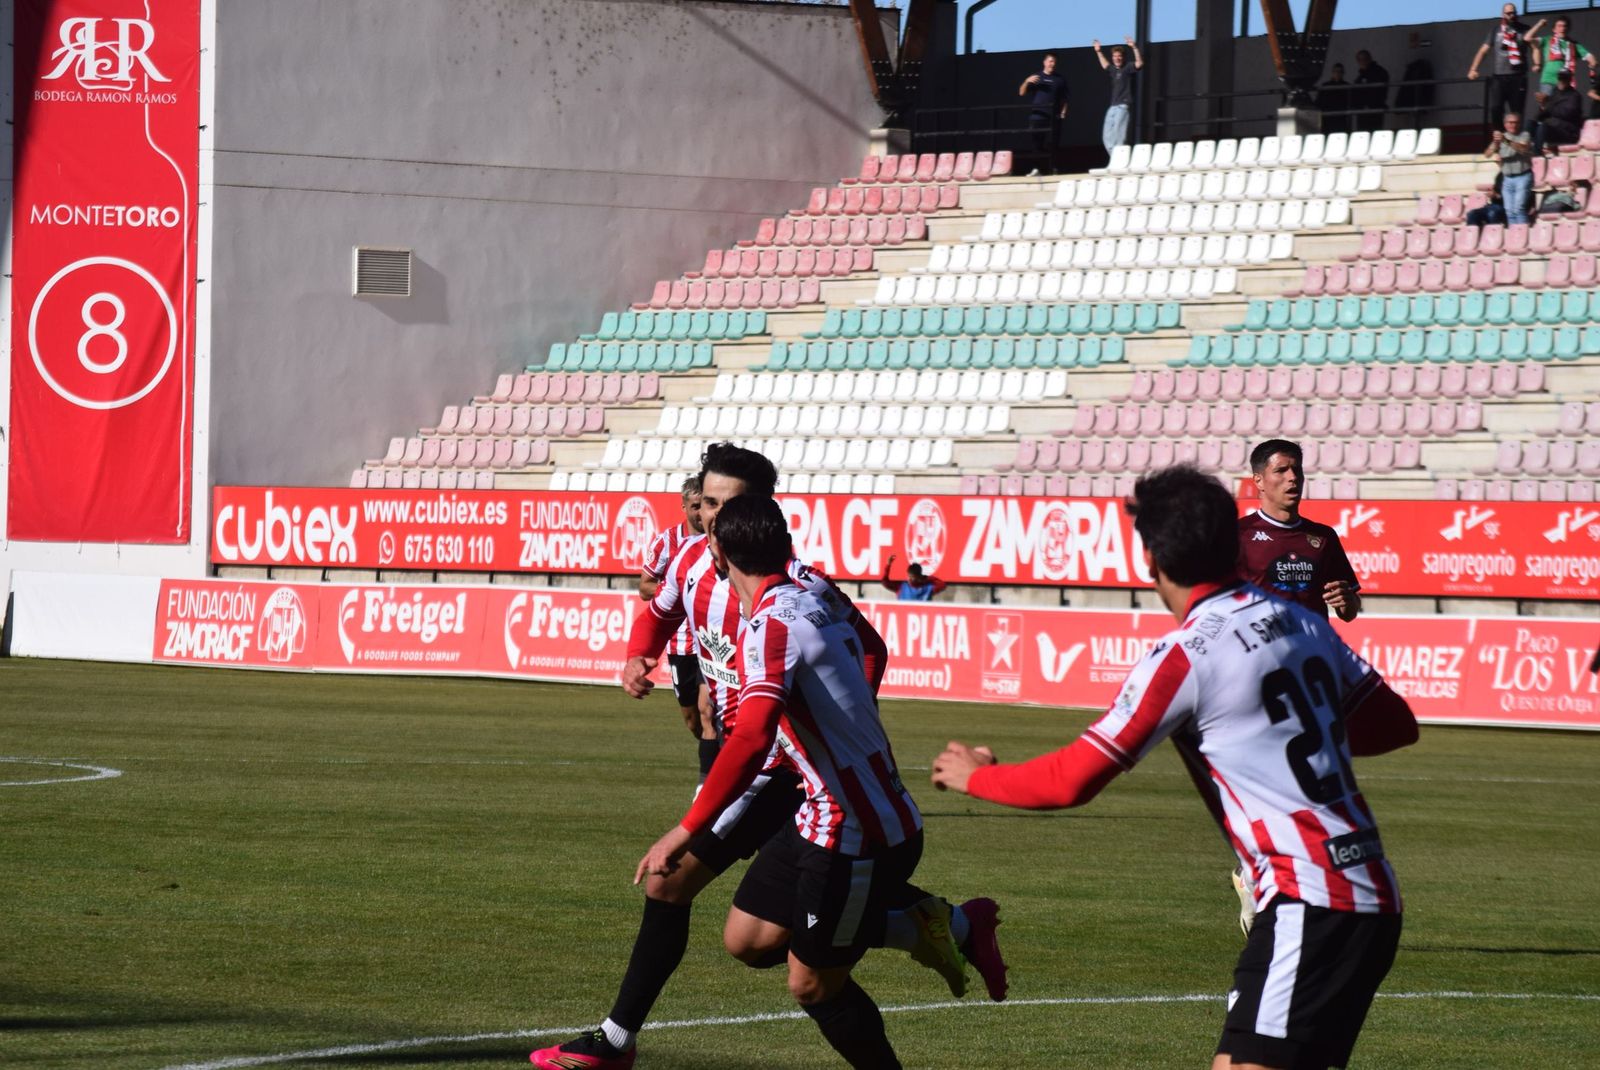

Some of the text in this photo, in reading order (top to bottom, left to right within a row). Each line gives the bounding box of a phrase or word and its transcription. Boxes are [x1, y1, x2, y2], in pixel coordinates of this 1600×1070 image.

[34, 90, 83, 102] BODEGA
[135, 93, 177, 104] RAMOS
[30, 204, 180, 228] MONTETORO
[77, 292, 128, 374] 8
[363, 494, 508, 525] www.cubiex.es
[520, 495, 609, 531] FUNDACIÓN
[215, 490, 358, 563] cubiex
[841, 498, 899, 576] CF
[404, 535, 494, 564] 675 630 110
[1347, 547, 1399, 580] regorio
[1422, 548, 1516, 583] sangregorio
[1276, 562, 1313, 571] Estrella
[1278, 571, 1311, 581] Galicia
[1525, 553, 1600, 586] sangrego
[167, 584, 256, 621] FUNDACIÓN
[361, 590, 467, 644] Freigel
[528, 594, 634, 652] Freigel
[906, 613, 970, 659] PLATA
[357, 650, 461, 662] A GOODLIFE FOODS COMPANY
[567, 658, 592, 669] FOODS
[1090, 636, 1160, 666] VALDE
[1361, 637, 1464, 678] ÁLVAREZ
